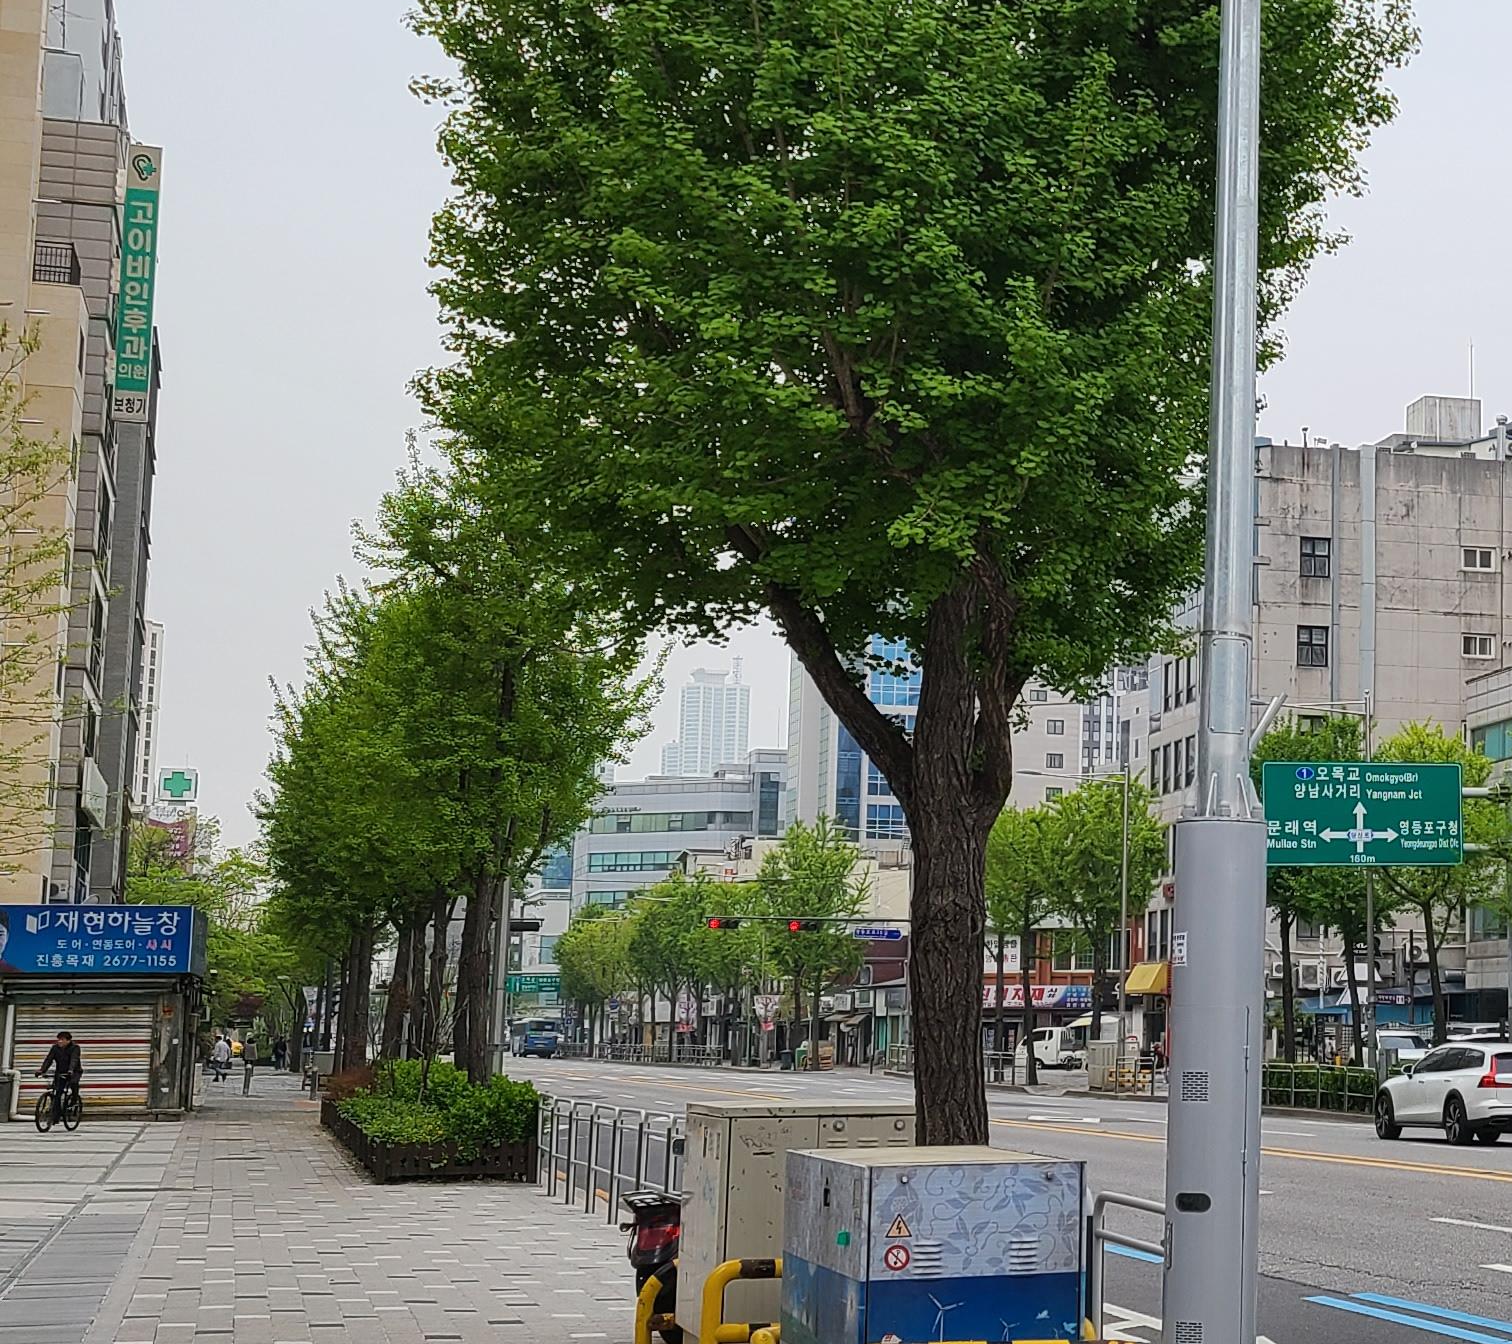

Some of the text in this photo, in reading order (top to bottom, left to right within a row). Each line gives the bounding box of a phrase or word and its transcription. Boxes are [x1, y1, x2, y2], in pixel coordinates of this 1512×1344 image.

[121, 202, 153, 360] 고이비인후과
[118, 363, 147, 379] 의원
[1316, 767, 1360, 781] 오목교
[1294, 783, 1422, 801] 양남사거리 Yangnam Jct
[1267, 820, 1317, 836] 문래역
[1399, 820, 1458, 836] 영등포구청
[1266, 839, 1317, 849] Mullae Stn
[54, 911, 181, 936] 재현하늘창
[36, 954, 177, 967] 진흥목재 2677-1155
